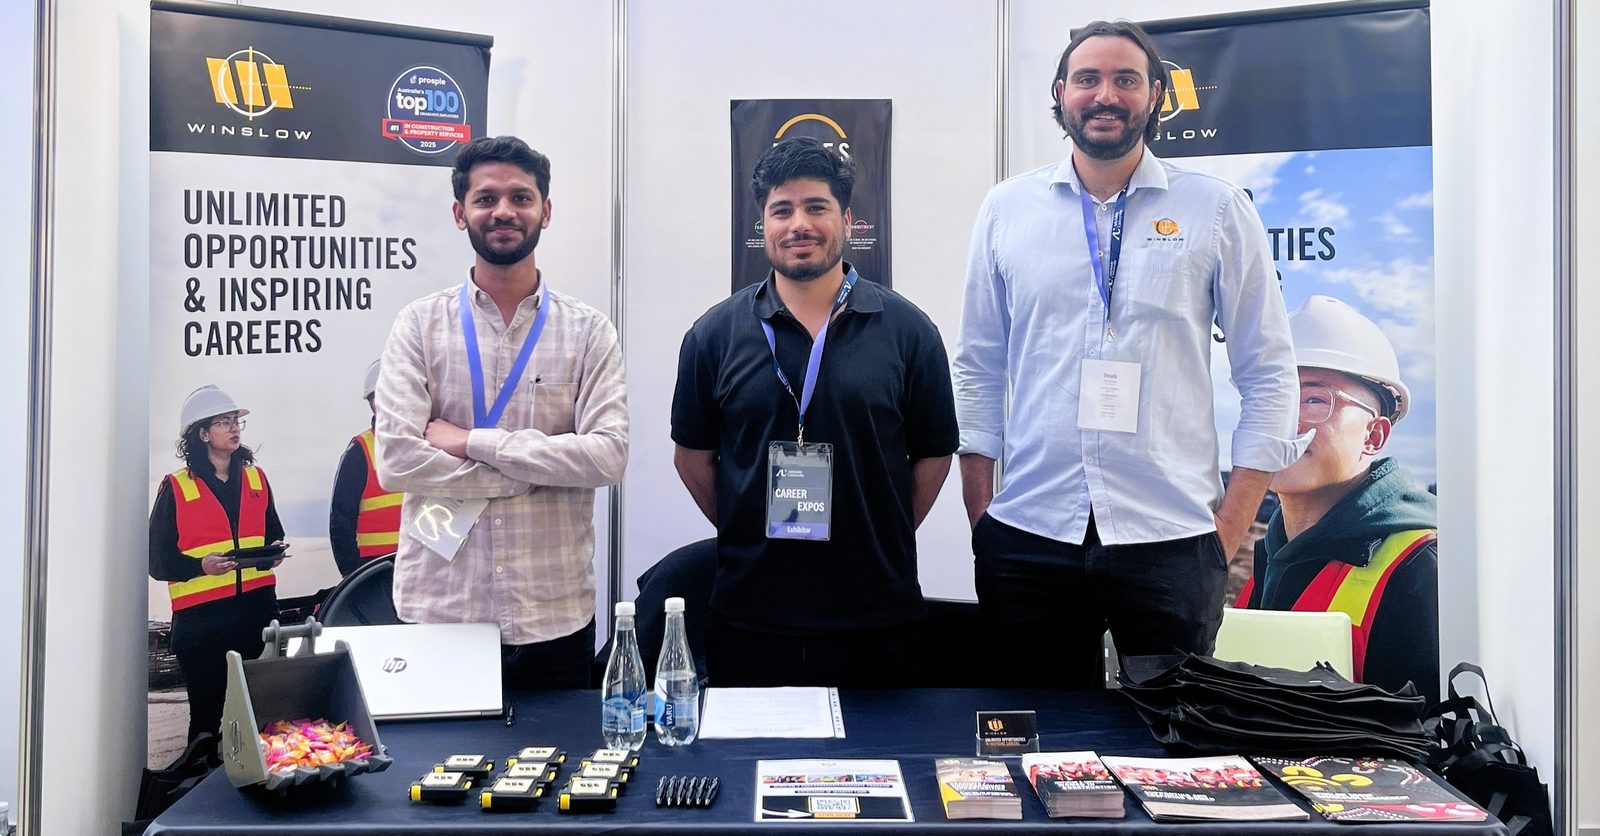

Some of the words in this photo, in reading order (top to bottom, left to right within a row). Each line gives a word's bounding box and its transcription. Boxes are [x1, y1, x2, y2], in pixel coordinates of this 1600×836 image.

[418, 77, 446, 86] prosple
[397, 87, 425, 95] Australia's
[187, 122, 312, 140] WINSLOW
[410, 129, 438, 137] PROPERTY
[411, 124, 455, 132] CONSTRUCTION
[184, 189, 346, 228] UNLIMITED
[184, 233, 417, 270] OPPORTUNITIES
[184, 276, 206, 313] &
[219, 276, 372, 312] INSPIRING
[184, 318, 322, 357] CAREERS
[775, 488, 807, 499] CAREER
[797, 501, 825, 512] EXPOS
[787, 526, 811, 534] Exhibitor
[382, 657, 408, 674] hp
